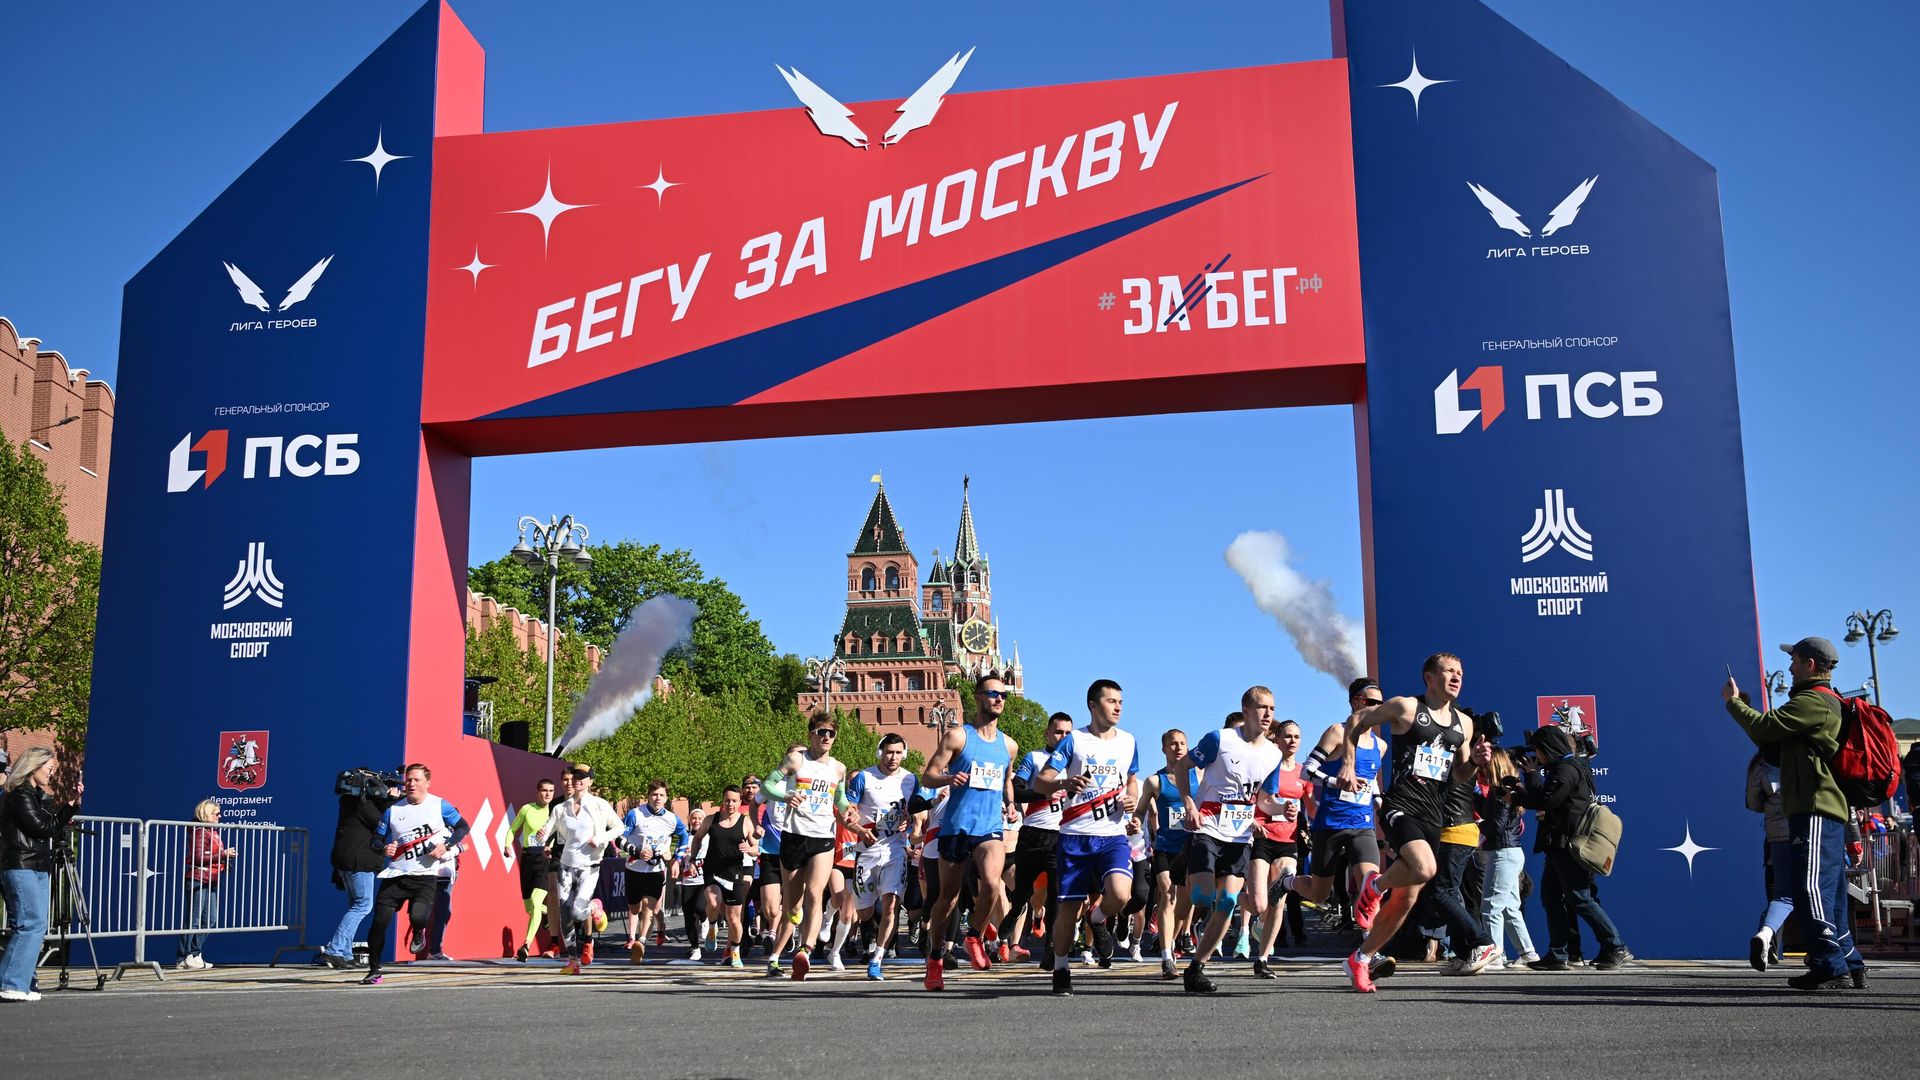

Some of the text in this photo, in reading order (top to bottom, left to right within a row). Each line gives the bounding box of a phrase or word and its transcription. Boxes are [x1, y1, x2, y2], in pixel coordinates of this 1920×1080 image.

[528, 101, 1179, 368] БЕГУ ЗА МОСКВУ
[1486, 244, 1590, 259] ЛИГА ГЕРОЕВ
[230, 318, 318, 332] ЛИГА ГЕРОЕВ
[1482, 336, 1619, 351] ГЕНЕРАЛЬНЫЙ СПОНСОР
[1525, 370, 1663, 420] ПСБ
[214, 402, 330, 416] ГЕНЕРАЛЬНЫЙ СПОНСОР
[243, 433, 360, 479] ПСБ
[1510, 572, 1608, 595] МОСКОВСКИЙ
[1537, 598, 1583, 616] СПОРТ
[210, 618, 293, 640] МОСКОВСКИЙ
[230, 641, 270, 659] СПОРТ
[974, 767, 1001, 779] 11450
[1085, 764, 1117, 775] 12893
[223, 809, 257, 819] спорта
[1224, 810, 1253, 820] 11556
[412, 823, 433, 839] ЗА
